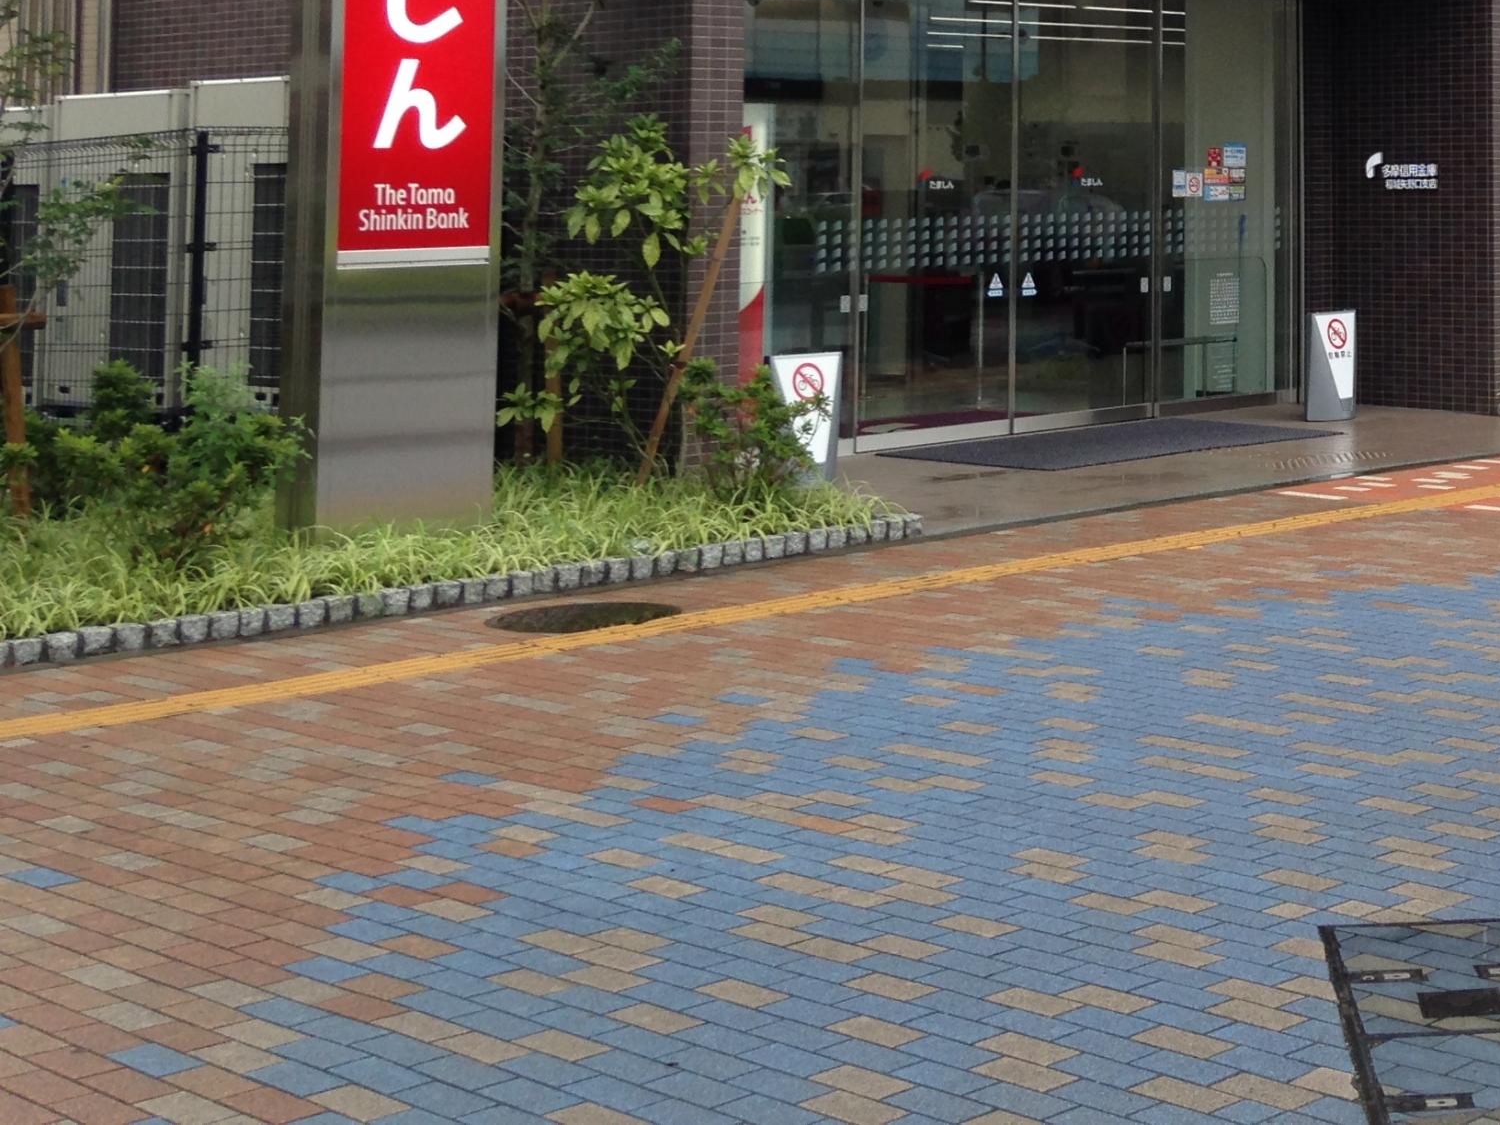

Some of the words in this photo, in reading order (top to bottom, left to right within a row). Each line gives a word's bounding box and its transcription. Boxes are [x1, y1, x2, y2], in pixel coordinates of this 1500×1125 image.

[929, 180, 954, 190] たましん
[1080, 178, 1103, 187] たましん
[373, 183, 407, 206] The
[407, 183, 456, 205] Tama
[358, 208, 423, 232] Shinkin
[426, 207, 469, 230] Bank
